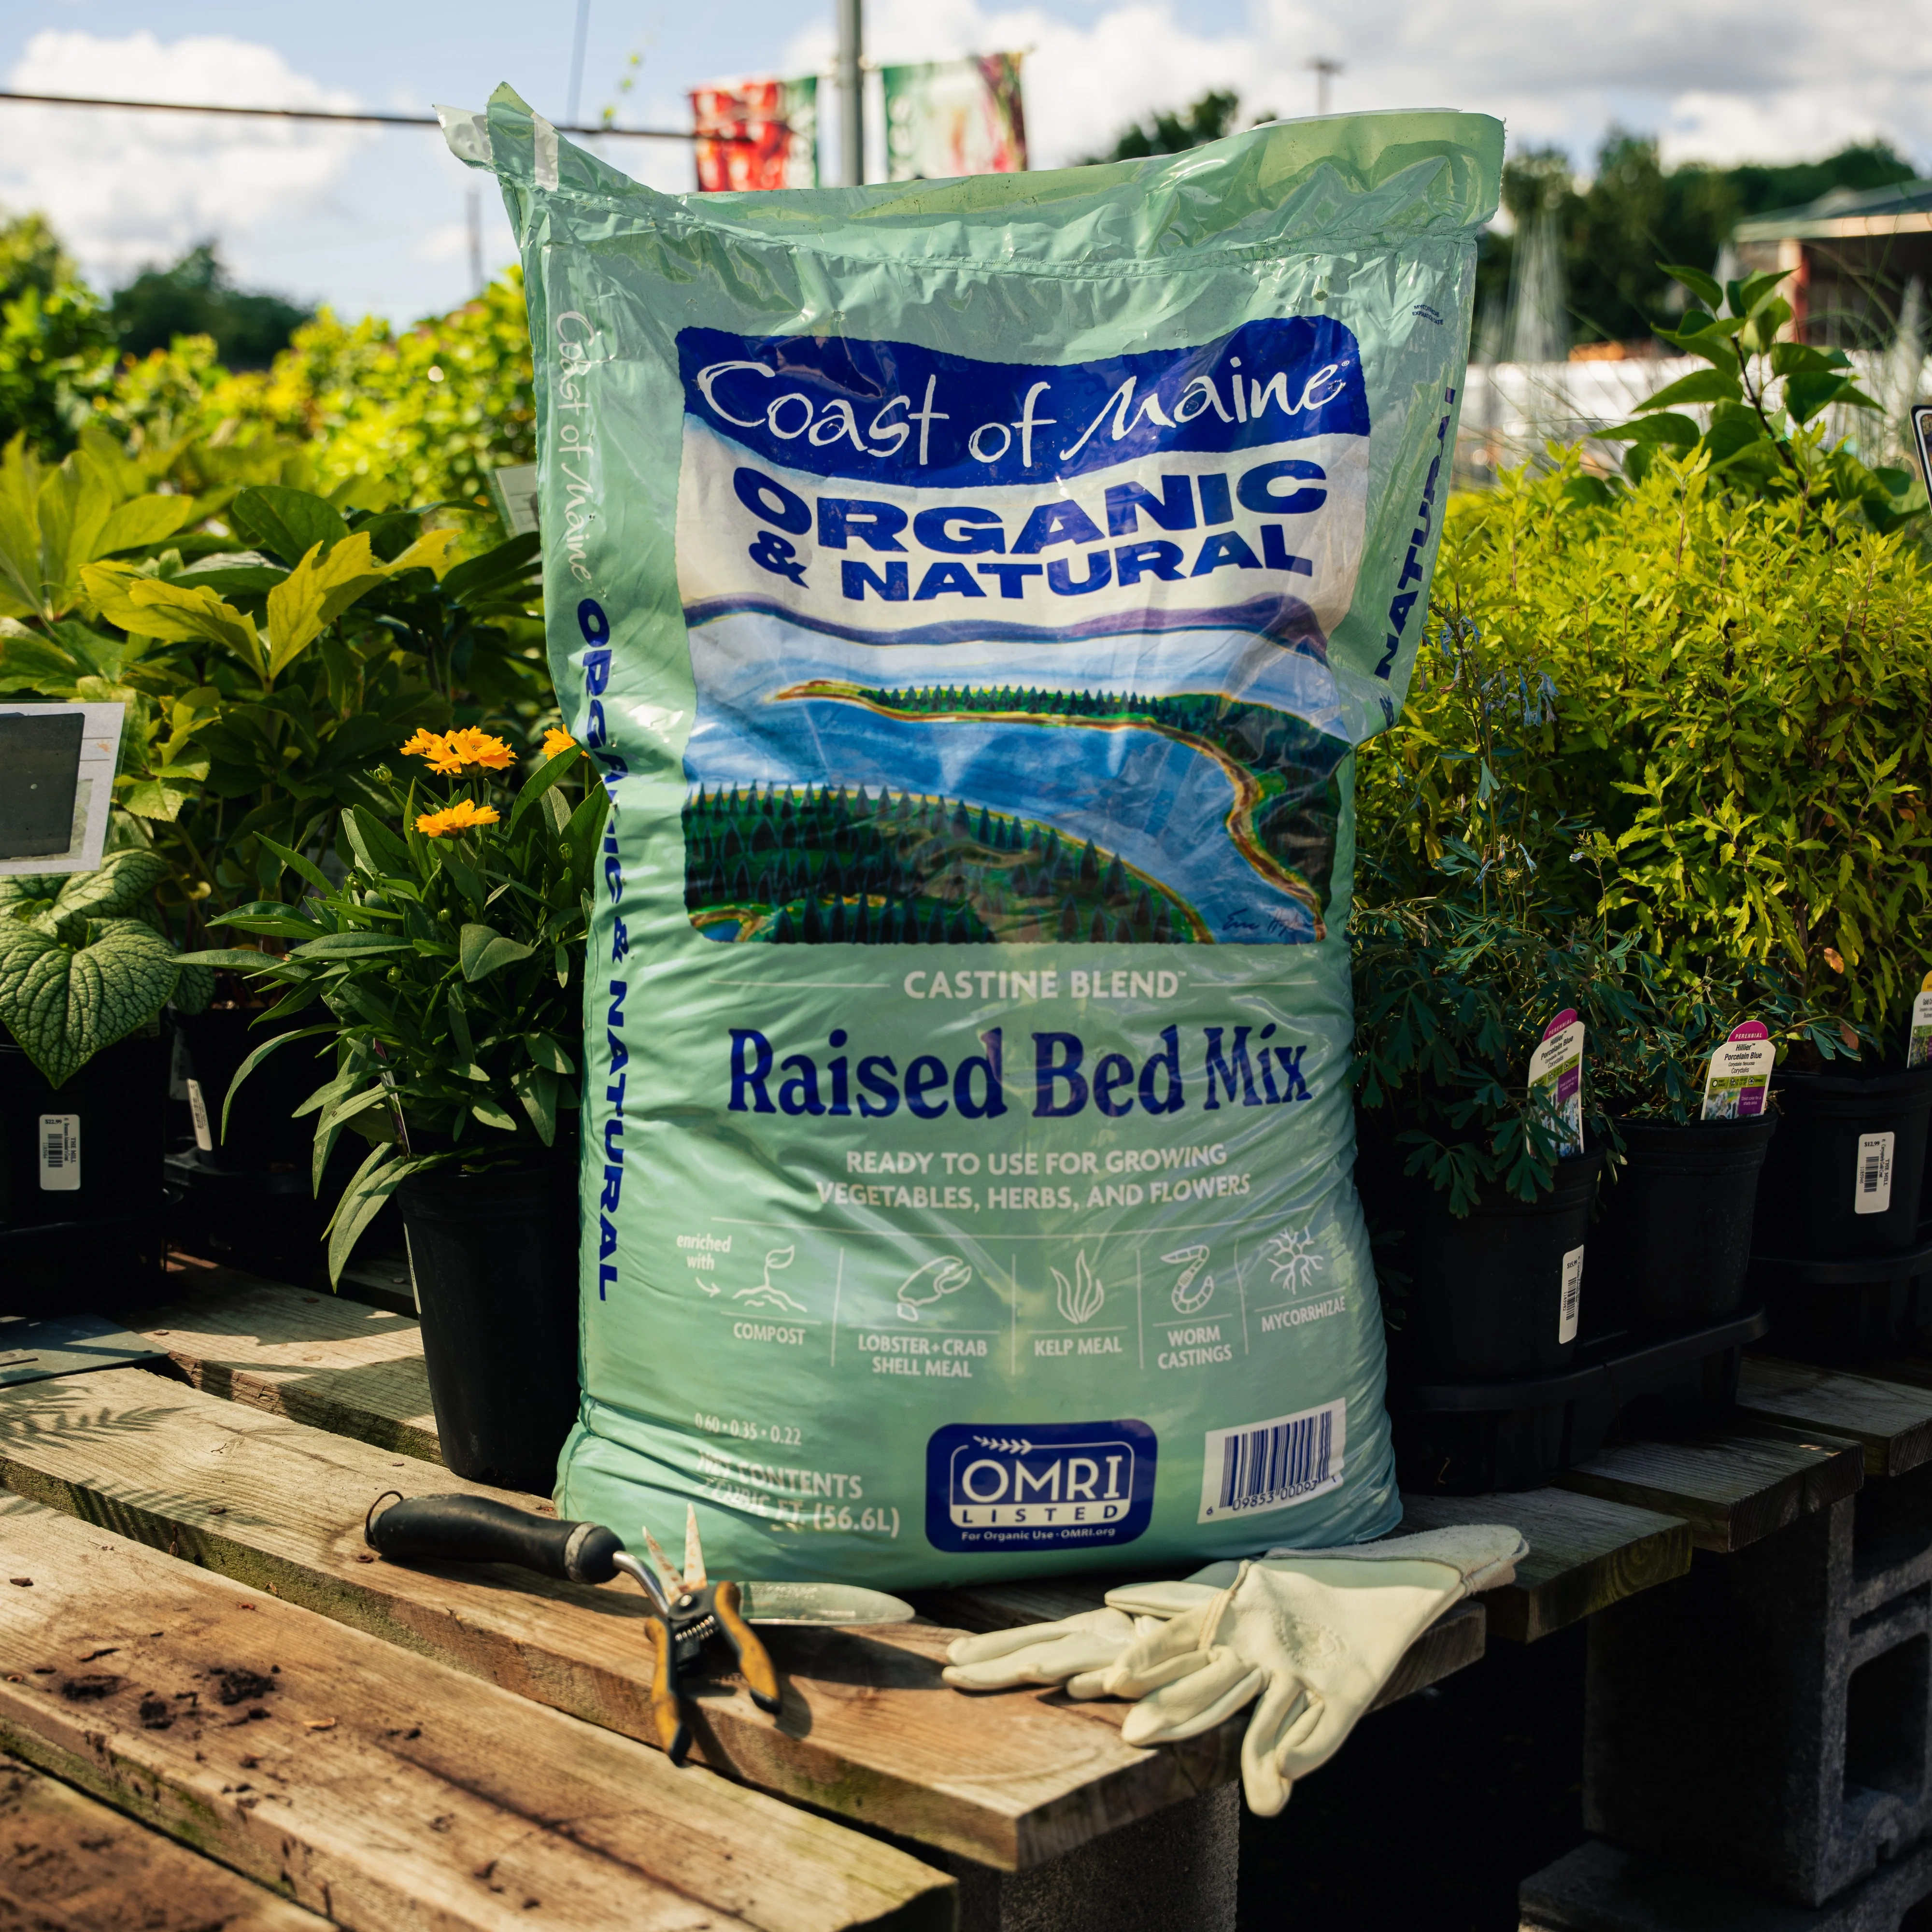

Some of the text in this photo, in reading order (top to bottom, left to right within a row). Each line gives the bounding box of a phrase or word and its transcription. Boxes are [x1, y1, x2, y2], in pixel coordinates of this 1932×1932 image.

[557, 312, 595, 416] Coast
[696, 360, 949, 465] Coast
[968, 382, 1051, 467] of
[559, 425, 594, 460] of
[733, 459, 1326, 555] ORGANIC
[749, 524, 1313, 602] & NATURAL
[612, 916, 629, 964] &
[904, 970, 1058, 999] CASTINE
[1548, 1018, 1572, 1036] PERENNIAL
[1541, 1036, 1573, 1060] Porcelain Blue
[1545, 1053, 1557, 1064] Corydalis
[1548, 1055, 1563, 1068] Corydalis
[727, 1023, 1312, 1119] Raised Bed Mix
[599, 980, 628, 1301] NATURAL
[847, 1143, 1227, 1176] READY TO USE FOR GROWING
[816, 1173, 1250, 1213] VEGETABLES, HERBS, AND FLOWERS
[676, 1233, 732, 1252] enriched
[686, 1253, 715, 1271] with
[1567, 1260, 1577, 1269] $15.99
[1262, 1295, 1346, 1333] MYCORRHIZAE
[733, 1322, 806, 1345] COMPOST
[1034, 1336, 1122, 1357] KELP MEAL
[1167, 1325, 1221, 1347] WORM
[872, 1357, 972, 1378] SHELL MEAL
[1158, 1344, 1233, 1370] CASTINGS
[738, 1461, 863, 1499] CONTENTS
[962, 1455, 1122, 1503] OMRI
[1207, 1506, 1213, 1515] 6
[1233, 1491, 1276, 1511] 09853
[1281, 1480, 1318, 1500] 00093
[813, 1502, 900, 1538] (56.6L)
[962, 1505, 1118, 1523] LISTED
[962, 1528, 1116, 1542] For Organic Use OMRI.org
